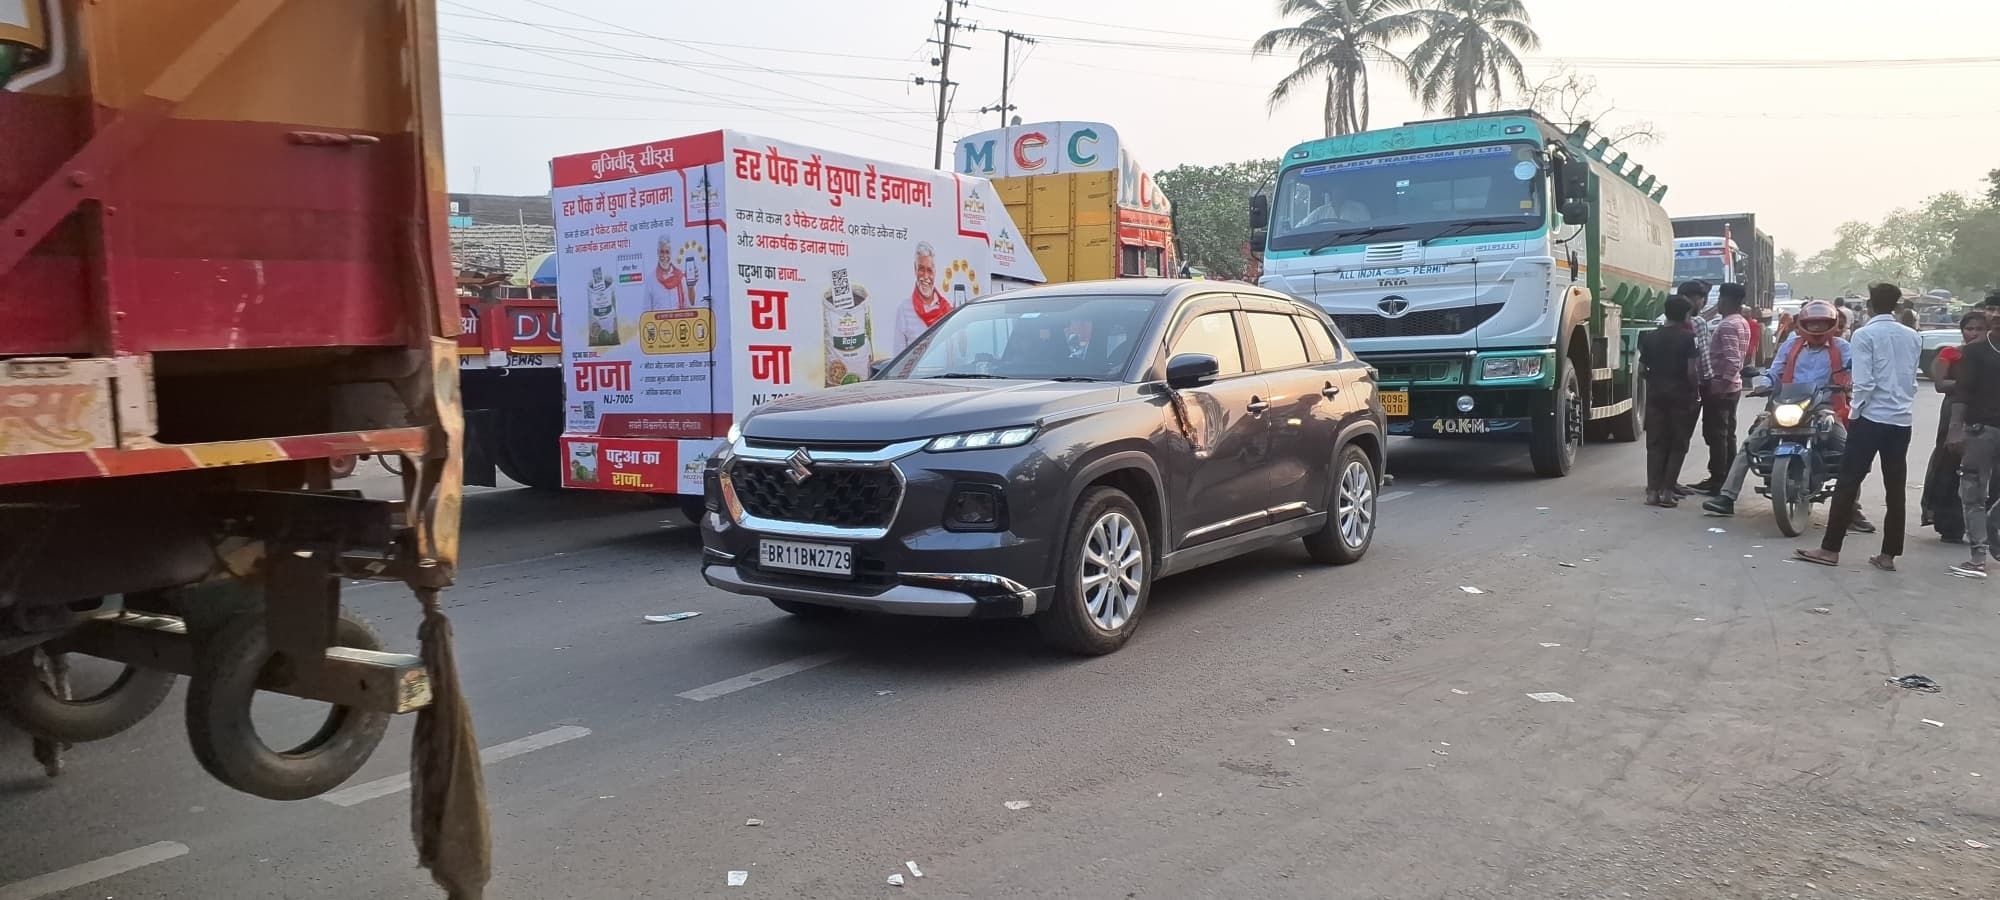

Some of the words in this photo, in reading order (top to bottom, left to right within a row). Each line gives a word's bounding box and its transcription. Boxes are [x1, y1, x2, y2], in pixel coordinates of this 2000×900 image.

[1328, 157, 1373, 171] RAJEEV
[1376, 151, 1455, 165] TRADECOMM
[1459, 148, 1475, 159] (P)
[733, 147, 761, 182] हर
[766, 145, 798, 187] पैक
[802, 154, 822, 191] में
[825, 165, 861, 207] छुपा
[864, 164, 878, 200] है
[880, 174, 932, 208] इनाम!
[562, 200, 575, 217] हर
[577, 194, 593, 214] पैक
[595, 192, 606, 212] में
[607, 192, 627, 218] छुपा
[629, 187, 637, 208] है
[639, 186, 673, 208] इनाम!
[735, 208, 754, 223] कम
[755, 208, 764, 225] से
[765, 212, 783, 226] कम
[784, 213, 791, 227] 3
[792, 209, 818, 231] पैकेट
[848, 224, 860, 237] QR
[860, 223, 876, 237] कोड
[876, 223, 895, 240] स्कैन
[895, 225, 908, 241] करें
[737, 230, 754, 247] और
[755, 233, 798, 251] आकर्षक
[799, 238, 828, 255] इनाम
[738, 264, 763, 284] पटुआ
[764, 266, 777, 281] का
[777, 267, 806, 282] राजा...
[1339, 271, 1357, 281] ALL
[1358, 269, 1382, 279] INDIA
[1413, 264, 1449, 275] PERMIT
[1377, 278, 1408, 287] TATA
[573, 361, 632, 392] राजा
[603, 394, 633, 404] NJ-7005
[605, 448, 640, 469] पटुआ
[642, 450, 661, 465] का
[612, 471, 654, 488] राजा...
